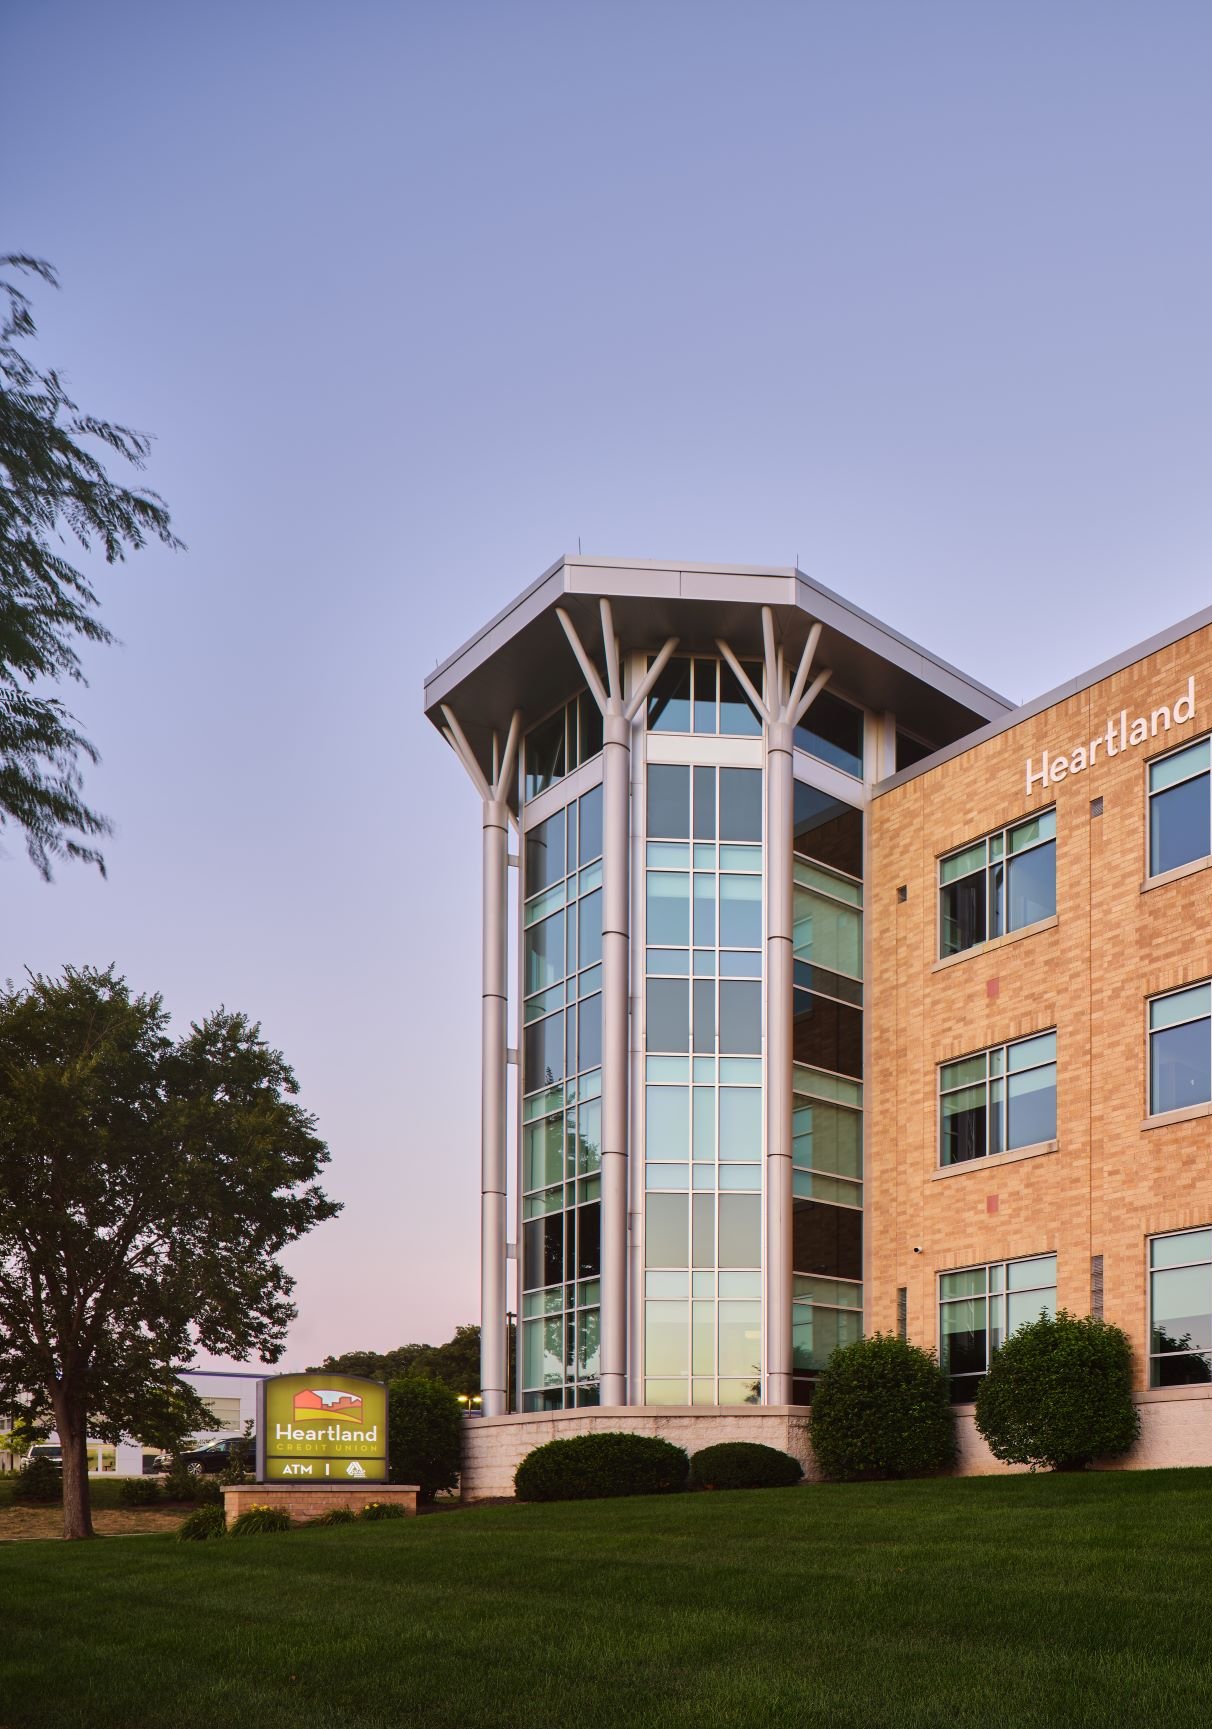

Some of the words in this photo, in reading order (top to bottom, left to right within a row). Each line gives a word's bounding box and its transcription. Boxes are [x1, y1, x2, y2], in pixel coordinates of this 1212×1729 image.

[1025, 676, 1196, 796] Heartland
[276, 1423, 377, 1442] Heartland
[276, 1443, 327, 1451] CREDIT
[335, 1443, 377, 1452] UNION
[282, 1463, 313, 1475] ATM
